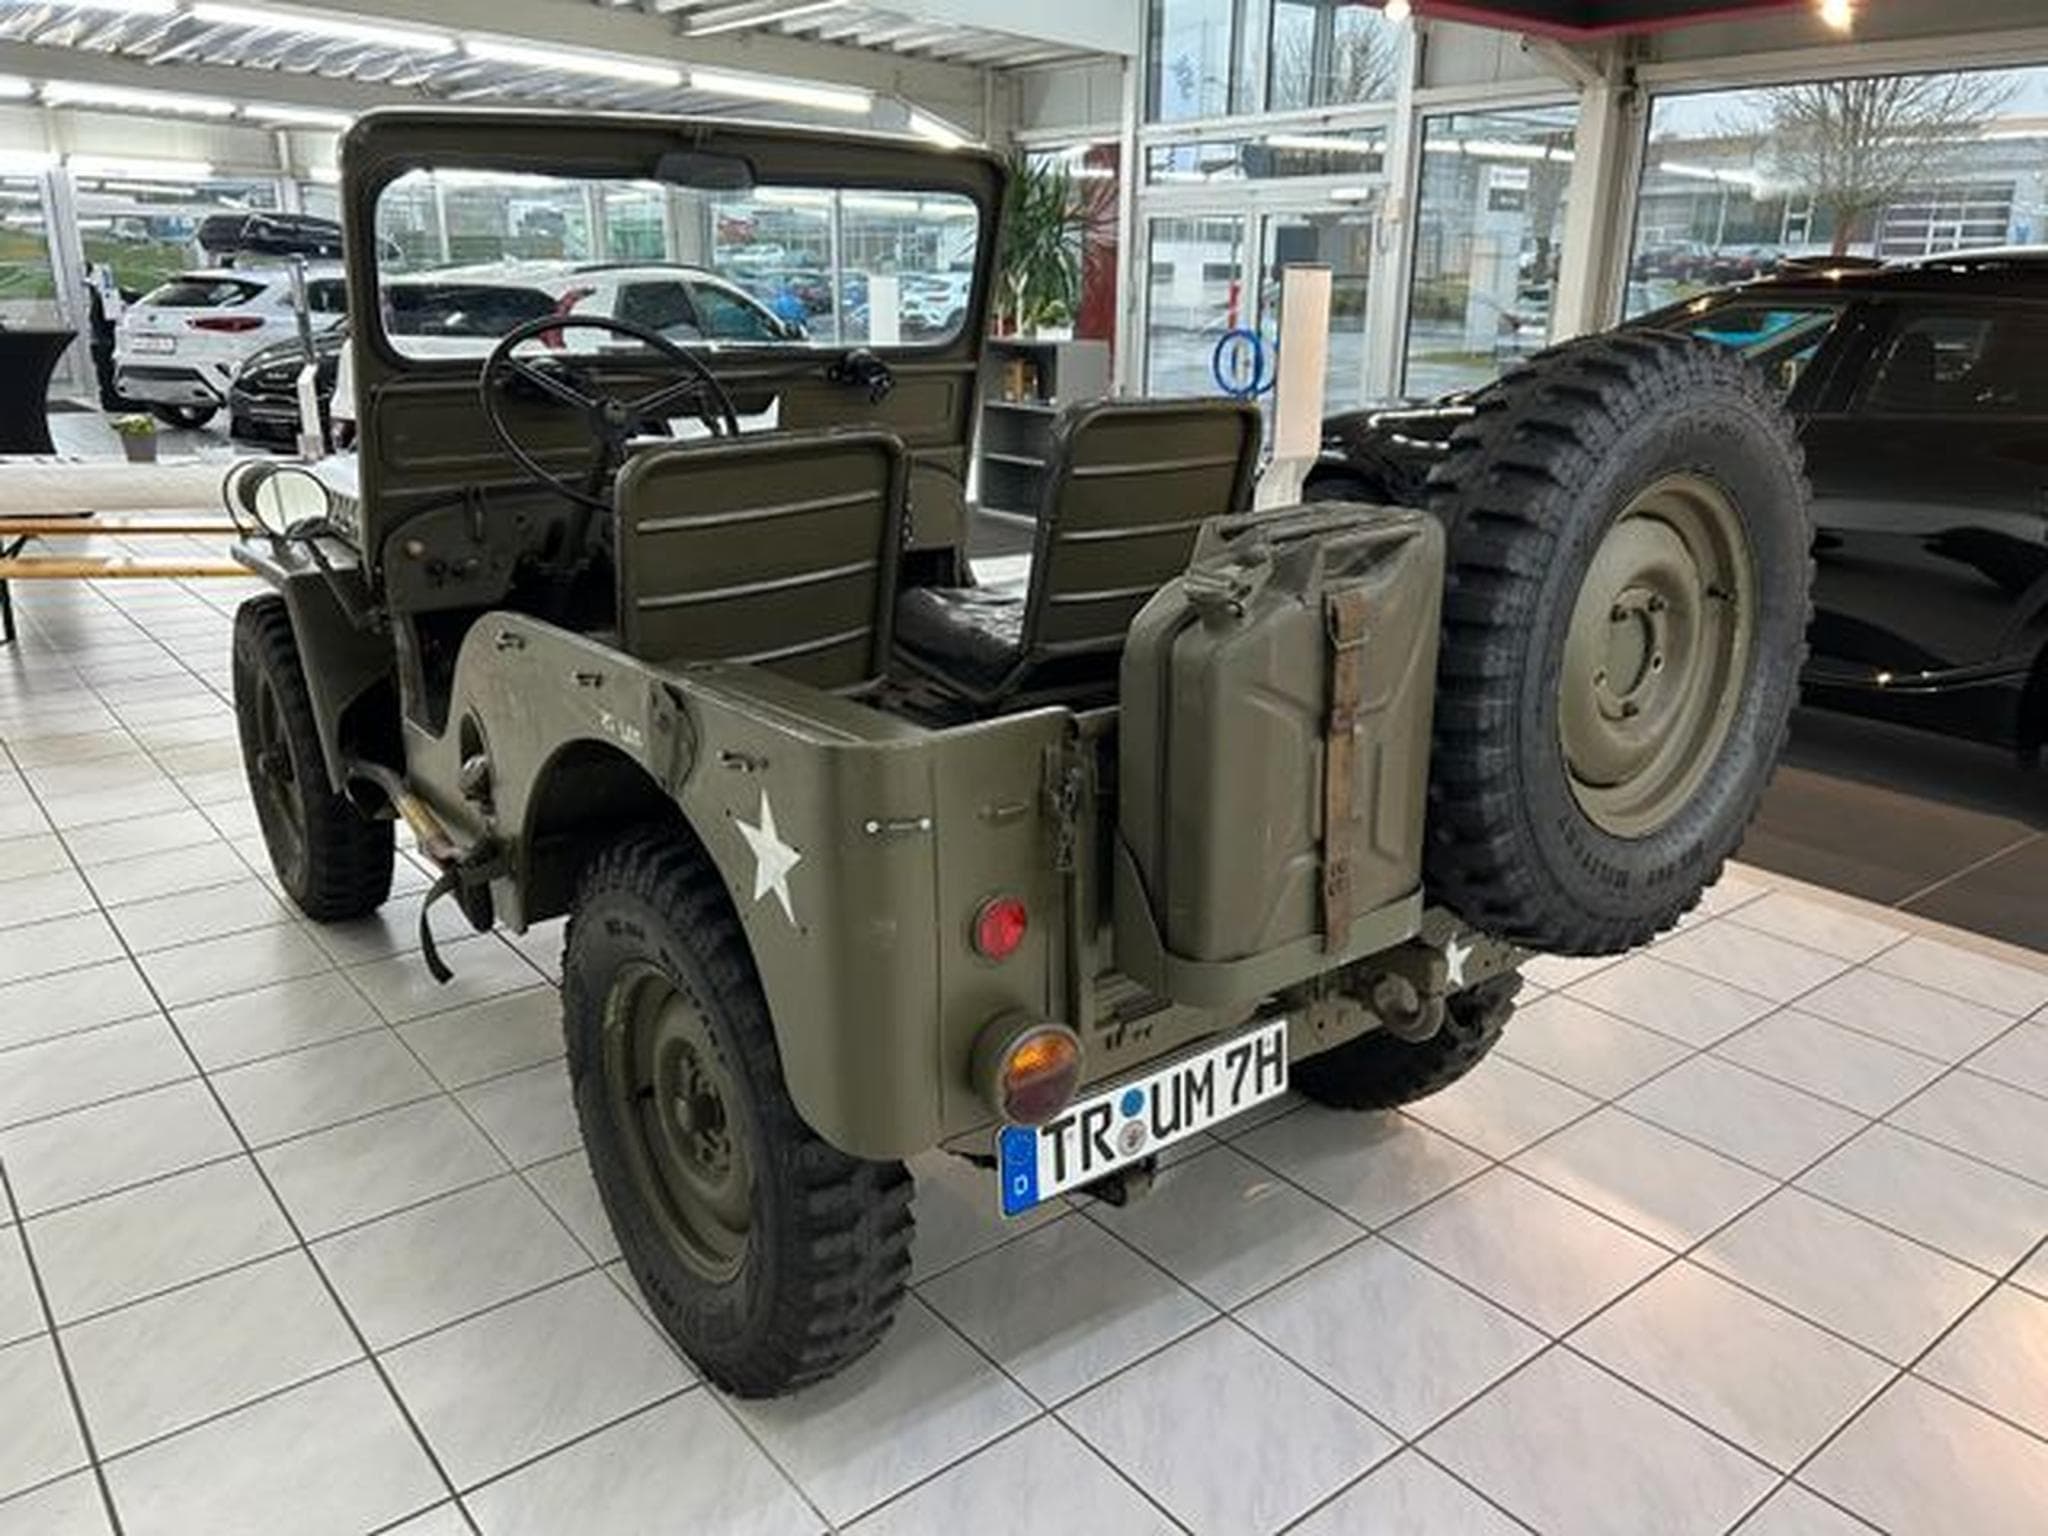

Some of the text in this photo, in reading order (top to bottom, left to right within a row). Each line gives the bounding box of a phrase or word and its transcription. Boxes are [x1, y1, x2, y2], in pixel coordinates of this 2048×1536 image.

[1040, 1029, 1283, 1183] TR UM 7H
